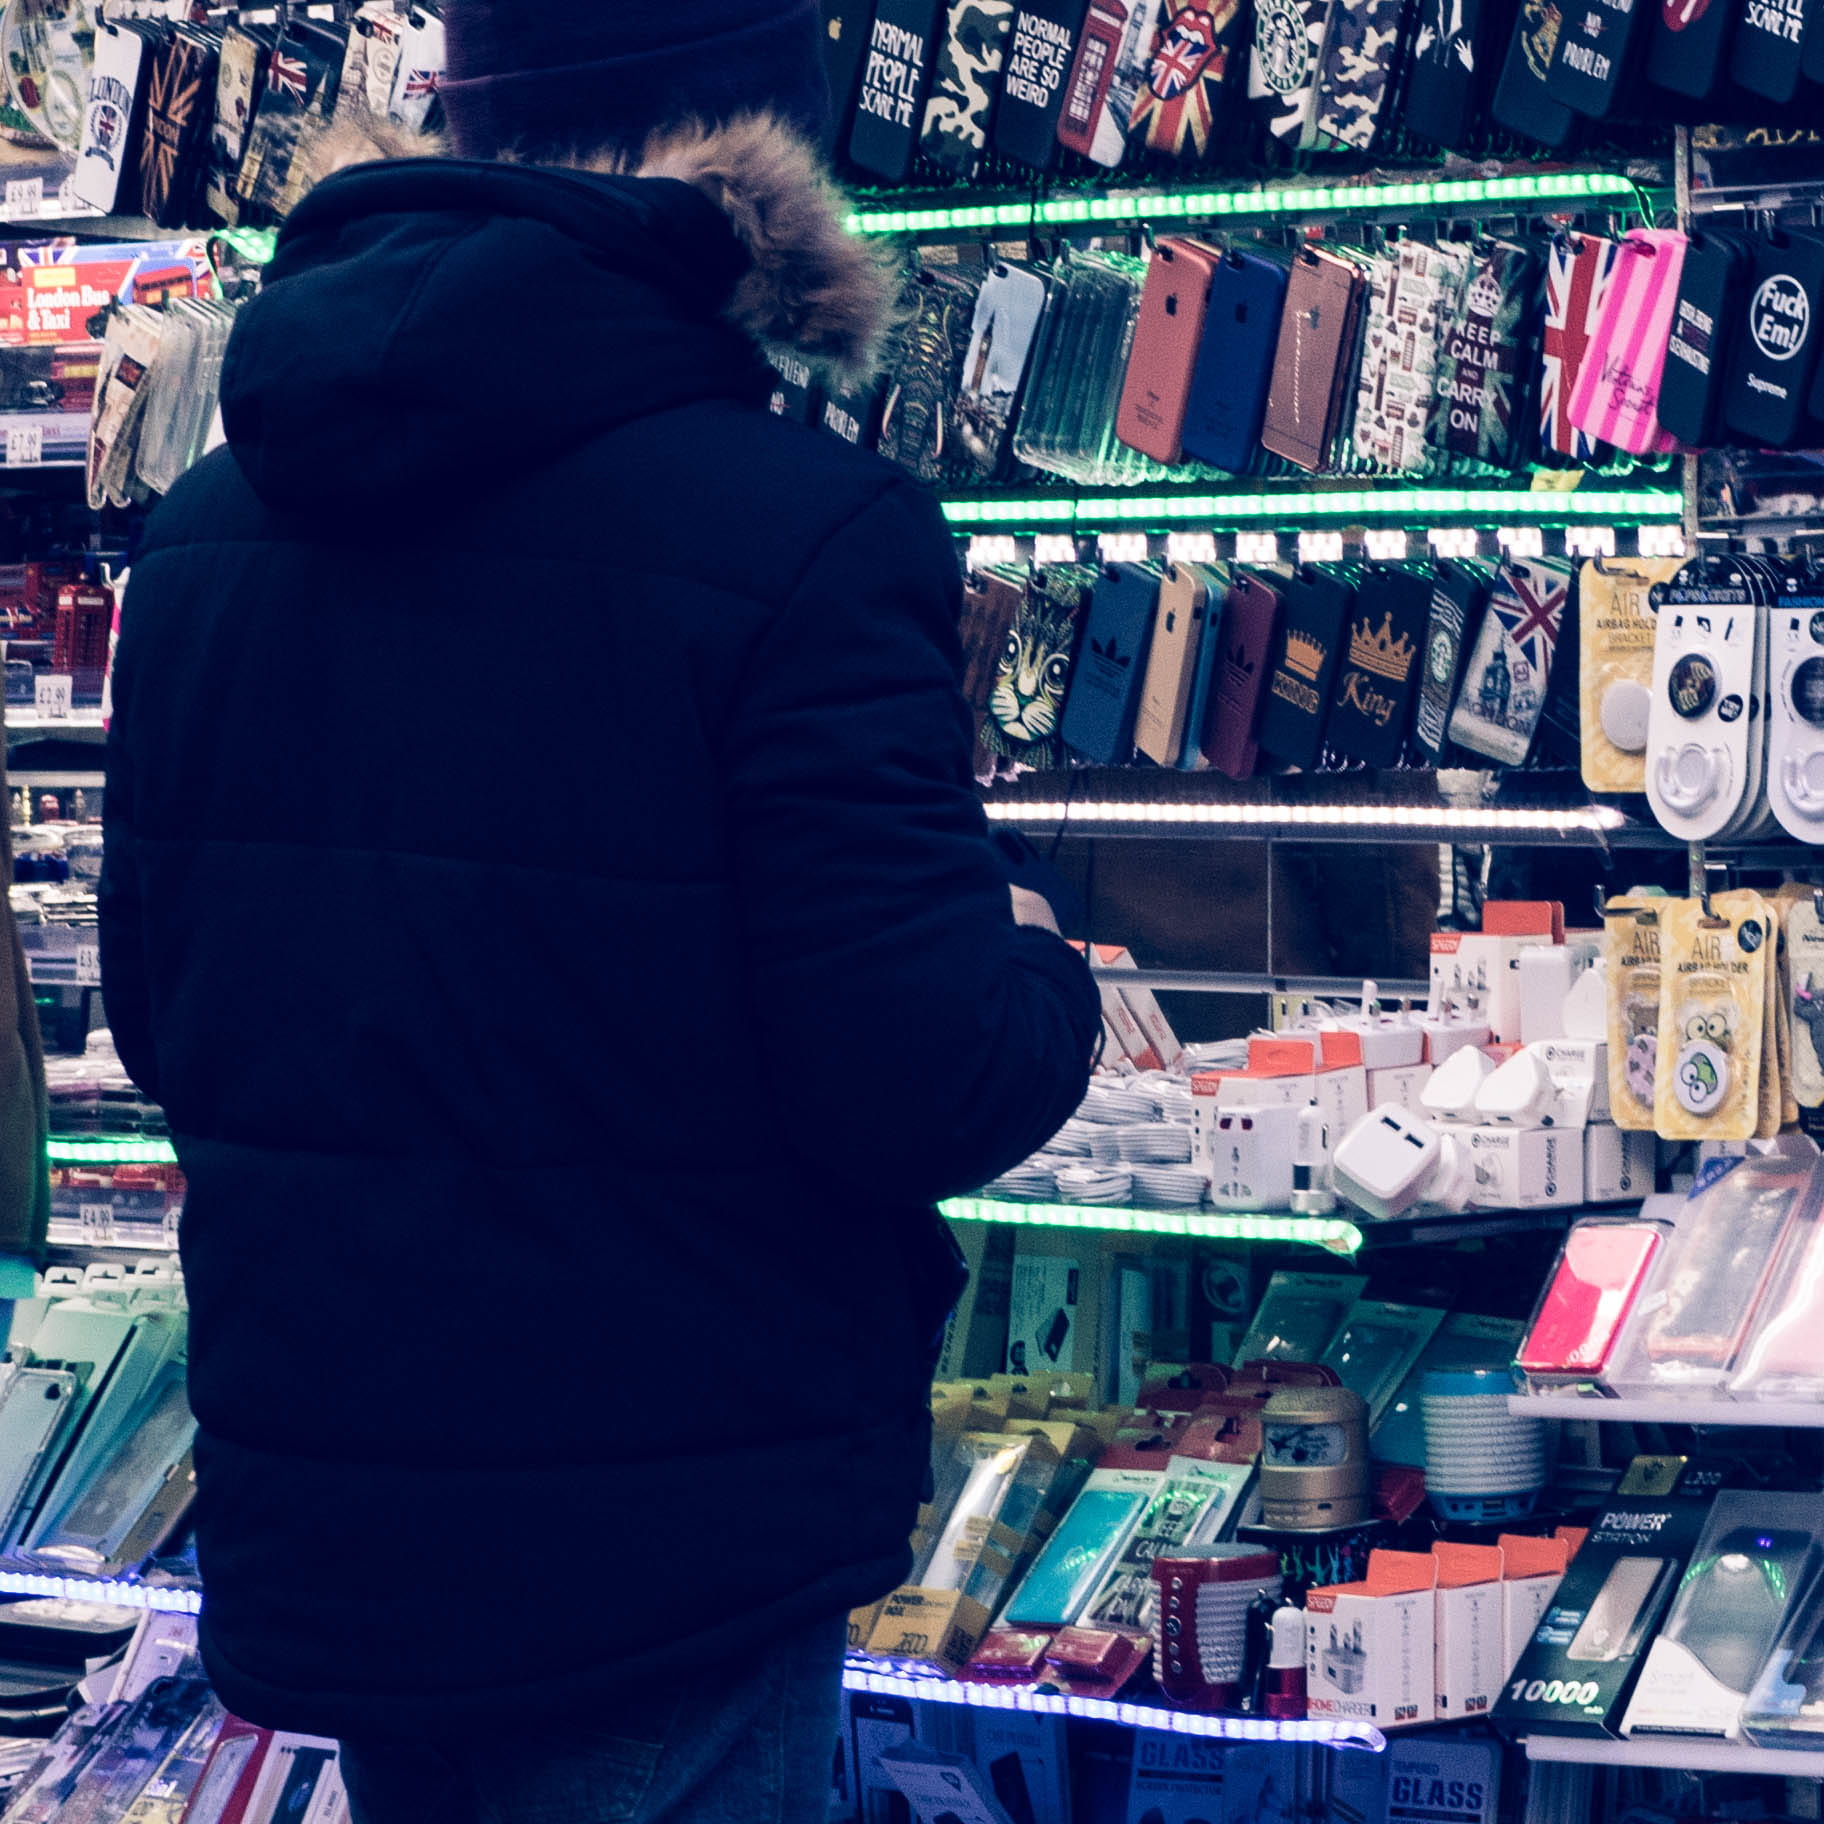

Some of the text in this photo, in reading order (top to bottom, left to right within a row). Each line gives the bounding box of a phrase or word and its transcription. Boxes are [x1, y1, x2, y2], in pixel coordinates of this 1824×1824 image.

[1017, 11, 1072, 50] NORMAL
[1744, 0, 1804, 45] SCARE ME
[870, 19, 924, 68] NORMAL
[1013, 32, 1066, 71] PEOPLE
[867, 53, 919, 104] PEOPLE
[1008, 53, 1060, 92] ARE SO
[1005, 74, 1049, 108] WEIRD
[859, 89, 914, 129] SCARE ME
[27, 286, 110, 309] London Bus
[1757, 275, 1807, 321] Fuck
[27, 308, 72, 330] & Taxi
[1455, 318, 1502, 346] KEEP
[1757, 314, 1800, 350] Em!
[1449, 339, 1498, 370] CALM
[1435, 376, 1498, 409] CARRY
[1746, 372, 1788, 401] Supreme
[1450, 407, 1478, 434] ON
[1610, 592, 1642, 615] AIR
[1273, 674, 1319, 715] KING
[1335, 673, 1396, 728] King
[1430, 937, 1459, 952] SPEEDY
[1691, 938, 1721, 962] AIR
[1602, 1510, 1667, 1533] POWER
[1509, 1678, 1600, 1706] 10000
[1139, 1740, 1226, 1772] GLASS
[1391, 1780, 1484, 1808] GLASS
